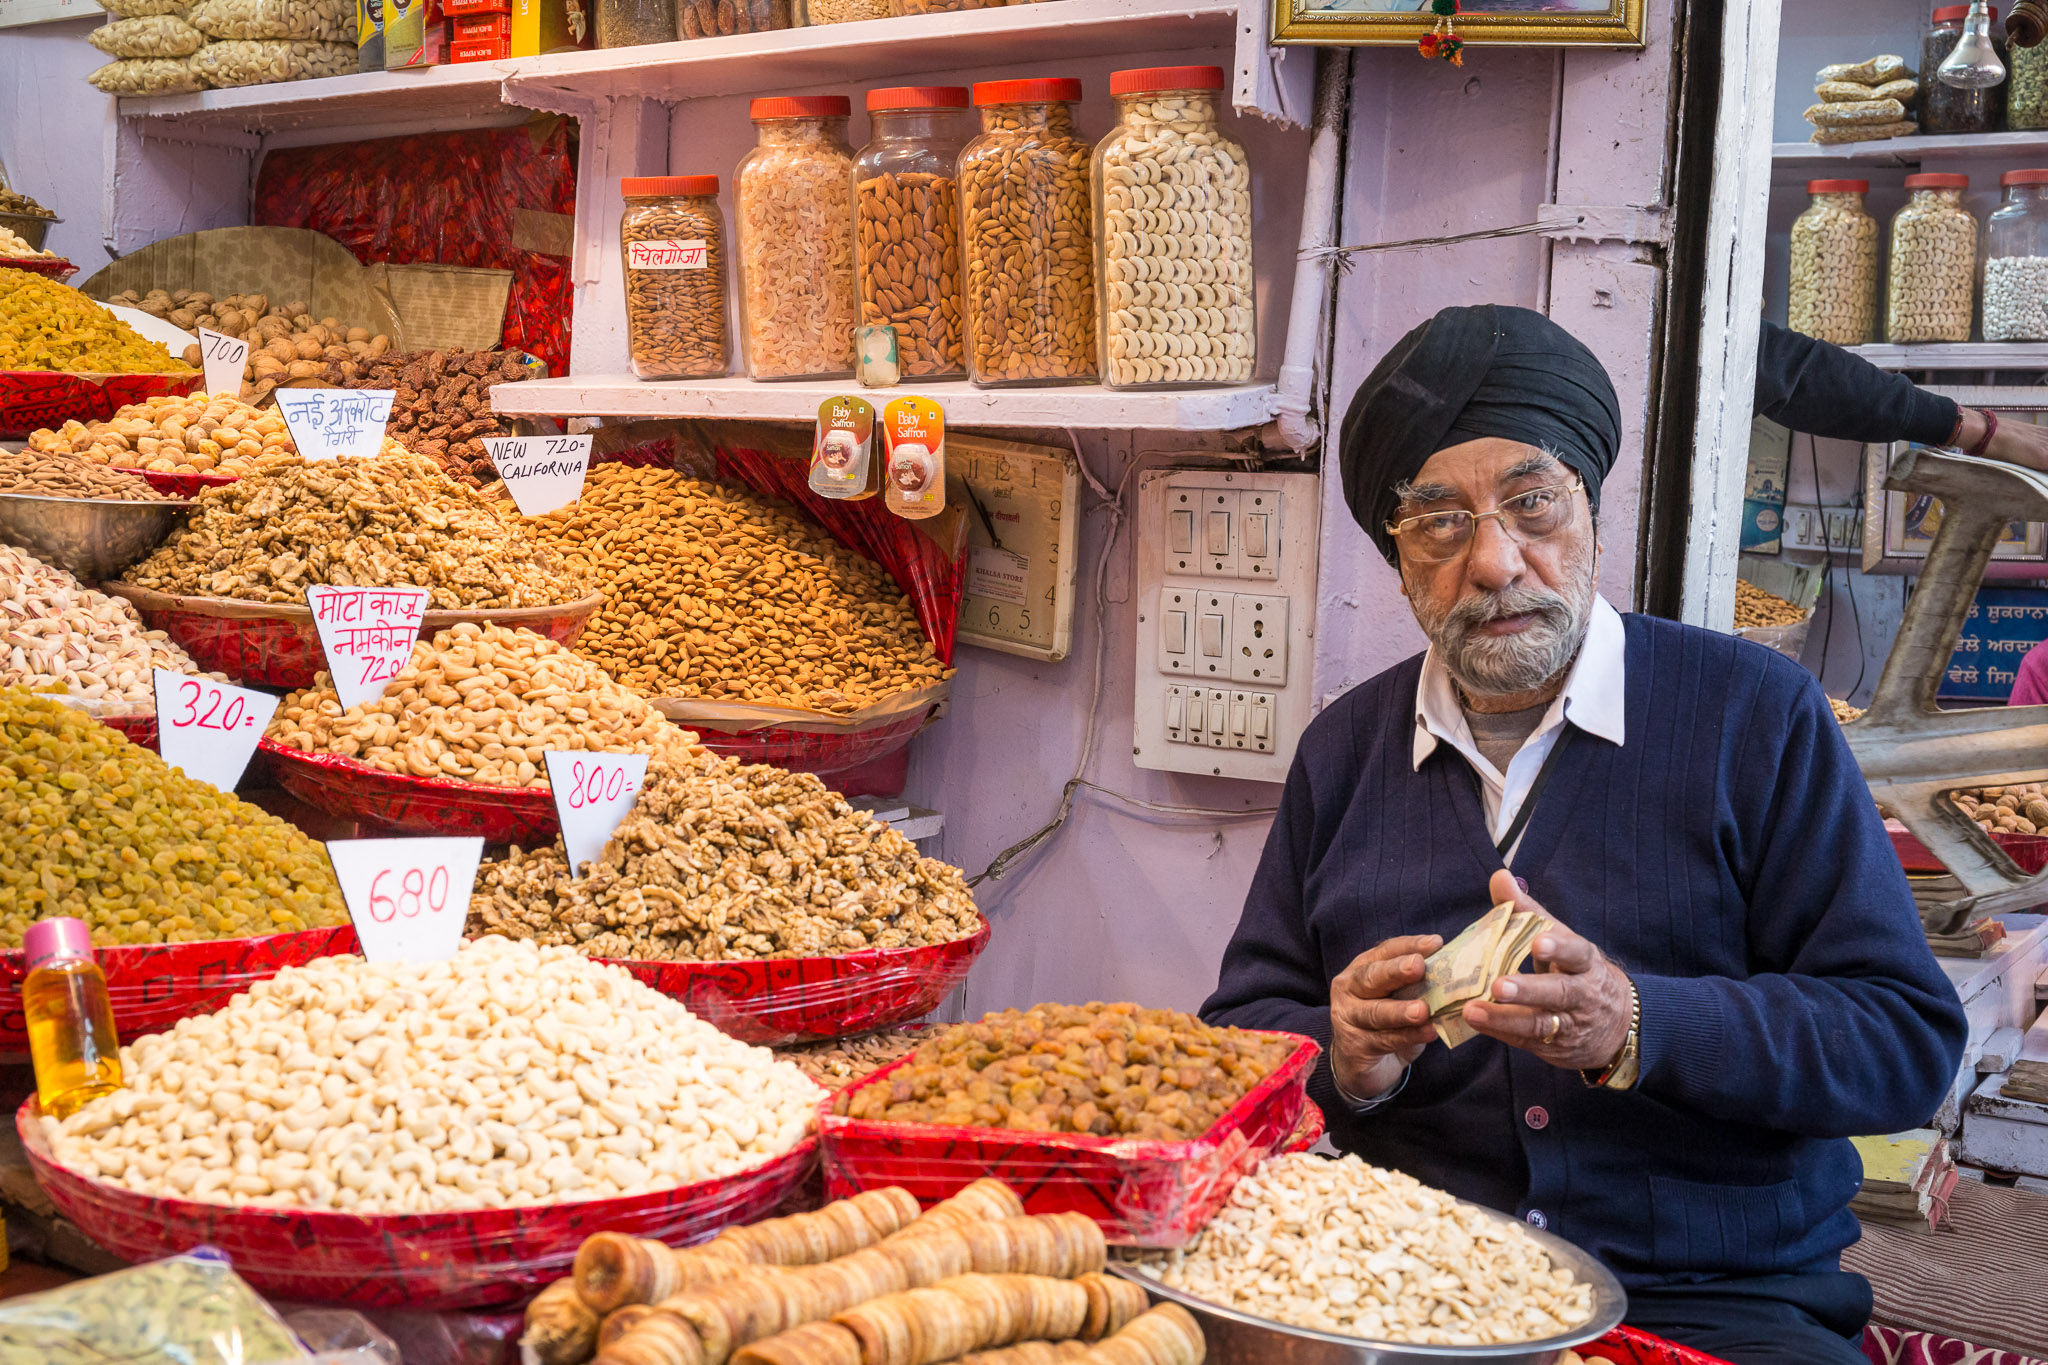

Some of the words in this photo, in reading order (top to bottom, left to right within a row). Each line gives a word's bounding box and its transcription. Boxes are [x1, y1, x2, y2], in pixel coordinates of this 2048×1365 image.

[478, 25, 492, 33] BLACK
[459, 50, 476, 58] PEPPER
[477, 48, 491, 56] BLACK
[204, 333, 244, 364] 700
[286, 393, 325, 430] नई
[329, 391, 395, 426] अखरोट
[832, 405, 852, 419] Baby
[897, 410, 920, 429] Baby
[830, 418, 856, 428] Saffron
[897, 427, 927, 438] Saffron
[491, 441, 527, 461] NEW
[501, 460, 582, 480] CALIFORNIA
[968, 458, 979, 479] 11
[995, 457, 1011, 482] 12
[1031, 467, 1037, 488] 1
[1049, 500, 1061, 521] 2
[1048, 543, 1059, 564] 3
[975, 567, 1001, 579] KHALSA
[1002, 572, 1024, 583] STORE
[315, 586, 368, 623] मोटा
[369, 591, 424, 620] काजू
[1044, 585, 1056, 606] 4
[988, 605, 1000, 626] 6
[1019, 609, 1031, 630] 5
[333, 619, 420, 656] नमकीन
[1948, 665, 1980, 683] ਵੇਲੇ
[369, 864, 449, 923] 680
